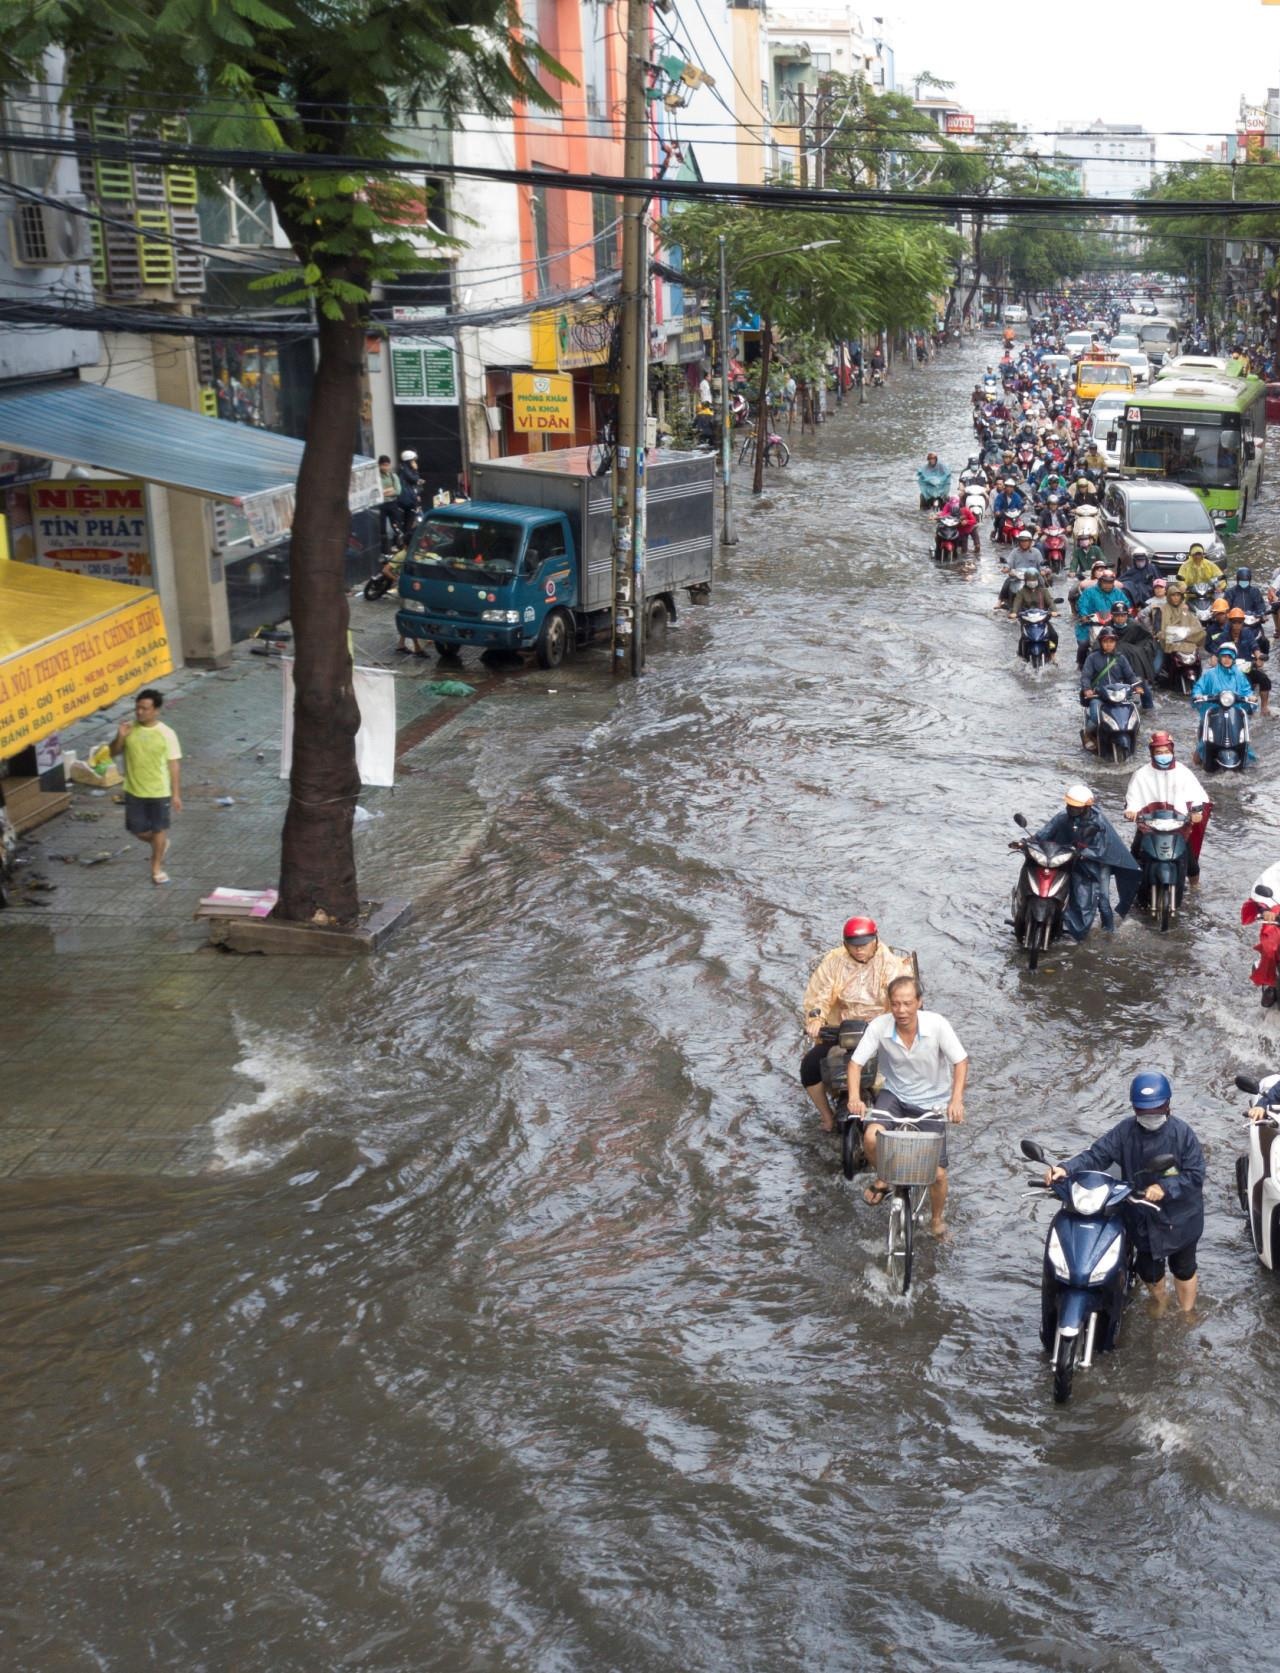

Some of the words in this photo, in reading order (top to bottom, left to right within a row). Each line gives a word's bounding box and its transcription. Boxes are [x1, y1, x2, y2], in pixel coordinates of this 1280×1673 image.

[947, 117, 973, 128] HOTEL
[519, 414, 532, 427] VÌ
[537, 414, 569, 428] DÂN
[1129, 409, 1139, 419] 24
[41, 515, 78, 536] TÍN
[86, 515, 144, 536] PHÁT
[72, 633, 102, 666] PHÁT
